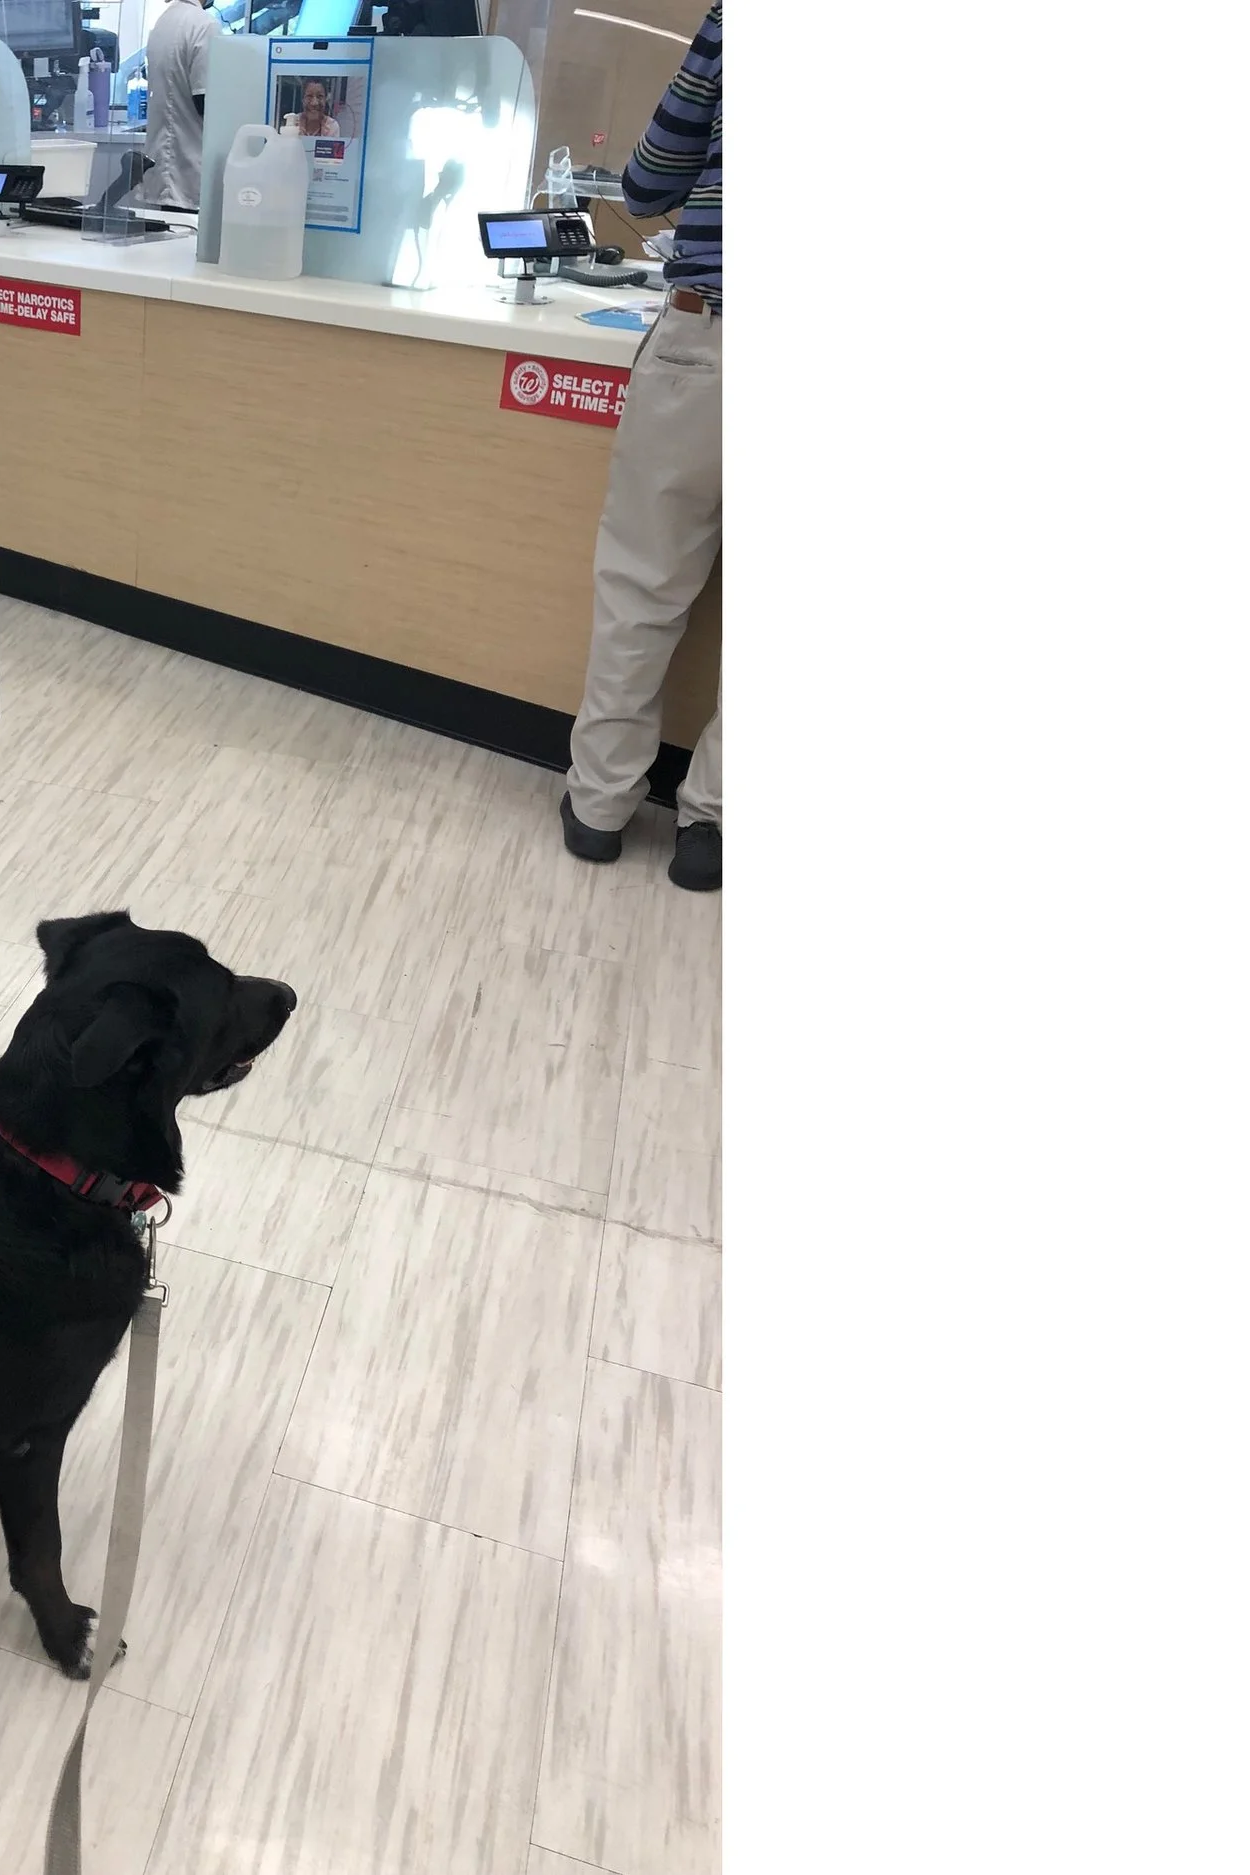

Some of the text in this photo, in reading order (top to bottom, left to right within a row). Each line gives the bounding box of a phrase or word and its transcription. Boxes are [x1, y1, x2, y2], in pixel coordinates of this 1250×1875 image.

[17, 291, 74, 311] NARCOTICS
[50, 309, 76, 325] SAFE
[552, 373, 614, 396] SELECT
[550, 389, 626, 416] IN TIME-D
